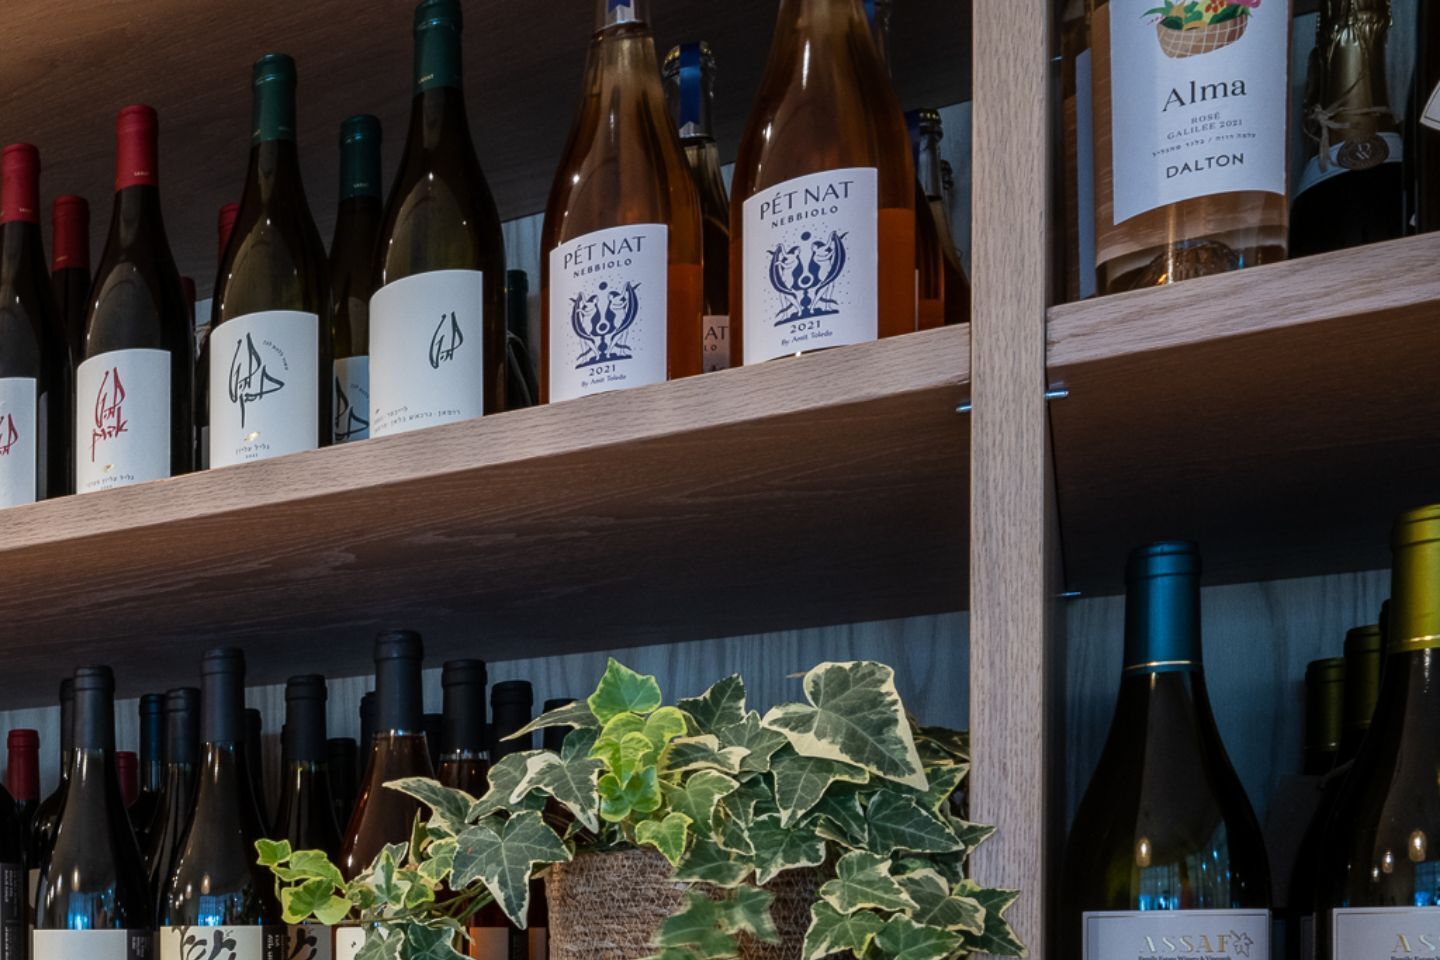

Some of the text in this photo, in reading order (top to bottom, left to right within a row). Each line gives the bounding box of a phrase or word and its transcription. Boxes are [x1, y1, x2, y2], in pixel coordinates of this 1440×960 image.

[1162, 79, 1247, 112] Alma
[1167, 119, 1243, 140] GALILEE 2021
[1166, 153, 1244, 179] DALTON
[760, 180, 854, 220] PÉT NAT
[770, 205, 839, 229] NEBBIOLO
[563, 235, 647, 270] PÉT NAT
[573, 258, 633, 279] NEBBIOLO
[704, 325, 729, 341] AT
[789, 320, 821, 334] 2021
[588, 364, 617, 377] 2021
[1138, 934, 1232, 954] ASSAF
